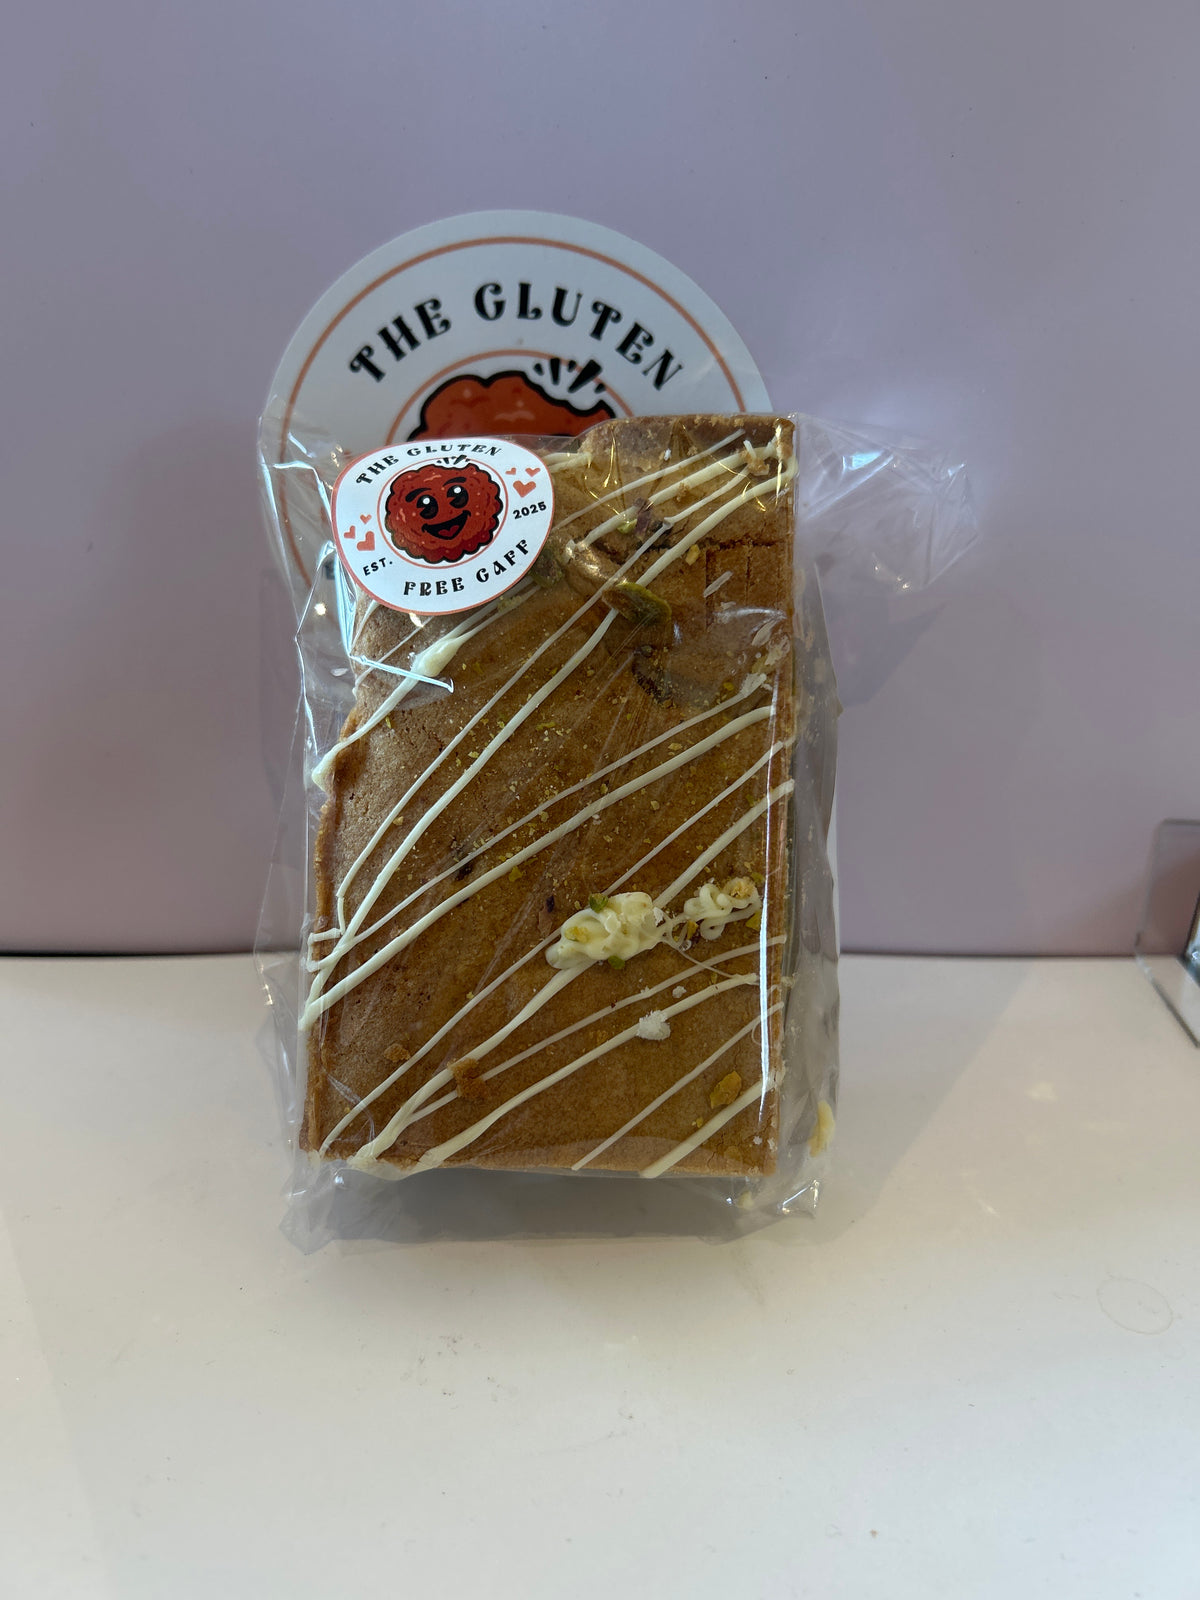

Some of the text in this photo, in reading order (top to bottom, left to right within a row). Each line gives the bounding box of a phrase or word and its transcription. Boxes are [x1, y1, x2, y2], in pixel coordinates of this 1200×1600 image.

[348, 282, 684, 391] THE GLUTEN
[356, 444, 502, 484] THE GLUTEN
[513, 501, 547, 520] 2025
[363, 557, 393, 576] EST.
[403, 539, 530, 597] FREE GAFF
